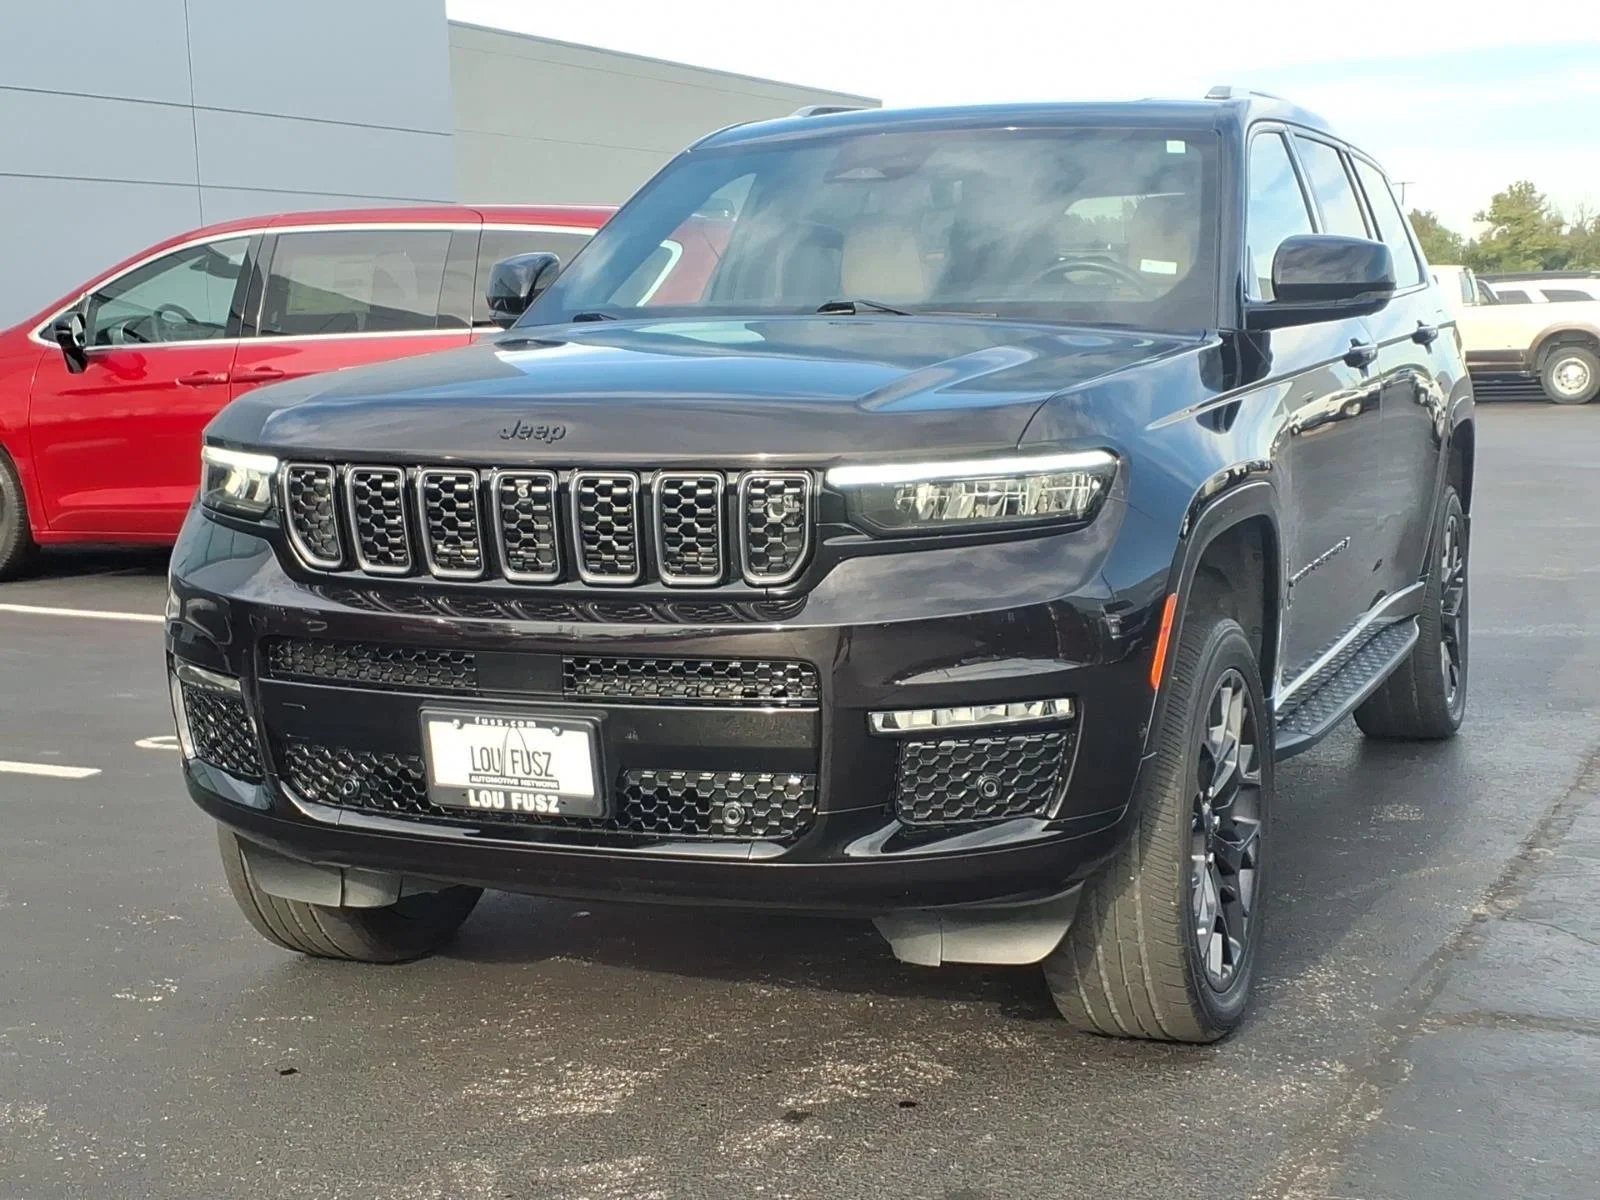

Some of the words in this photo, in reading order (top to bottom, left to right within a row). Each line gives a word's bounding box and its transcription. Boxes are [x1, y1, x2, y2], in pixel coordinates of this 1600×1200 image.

[498, 419, 567, 445] Jeep
[470, 745, 501, 773] LOU
[510, 749, 554, 777] FUSZ
[470, 775, 519, 786] AUTOMOTIVE
[520, 779, 558, 789] NETWORK
[468, 789, 505, 809] LOU
[511, 792, 560, 813] FUSZ
